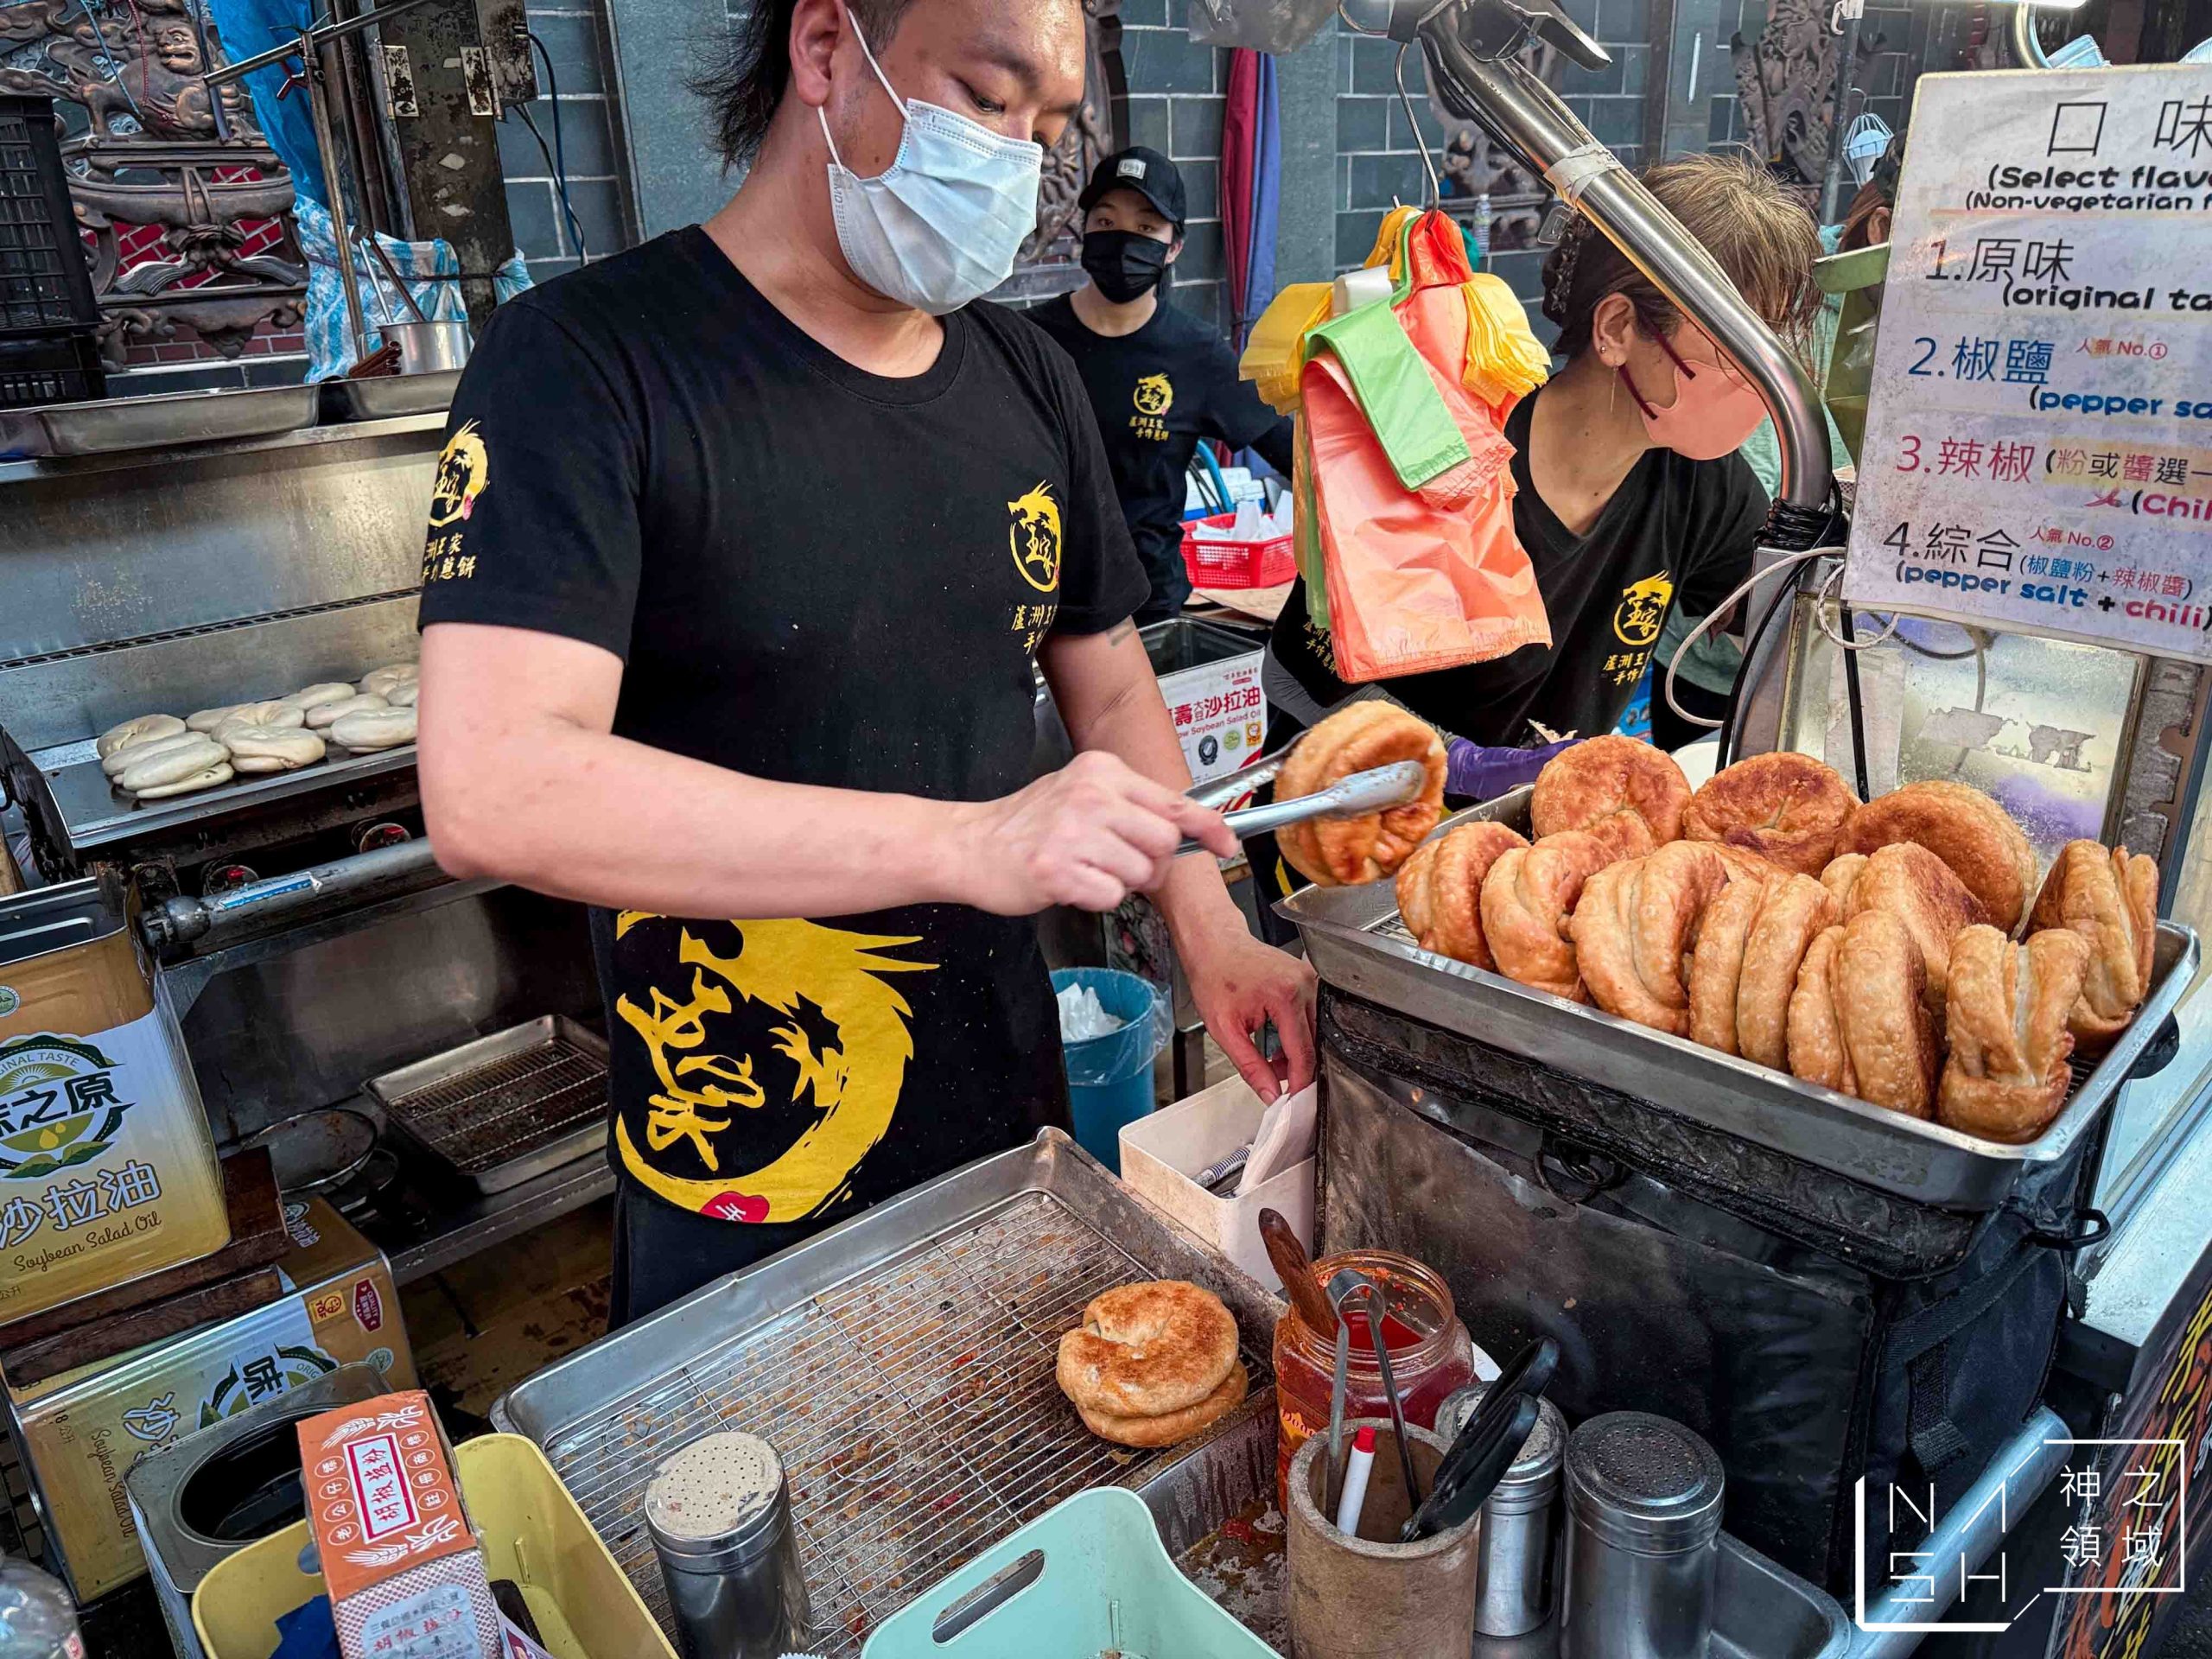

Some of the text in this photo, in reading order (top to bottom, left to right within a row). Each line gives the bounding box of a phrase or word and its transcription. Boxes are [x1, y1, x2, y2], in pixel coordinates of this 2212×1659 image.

[1988, 163, 2212, 190] (Select flav
[1966, 191, 2193, 213] (Non-vegetarian
[2030, 385, 2163, 417] (pepper
[1897, 435, 2037, 484] 3.辣椒
[1883, 521, 2021, 573] 4.綜合
[1896, 560, 2012, 595] (pepper
[2020, 581, 2088, 607] salt
[37, 1052, 80, 1068] TASTE
[14, 1211, 162, 1272] Soybean Salad Oil
[315, 1300, 327, 1319] TQF
